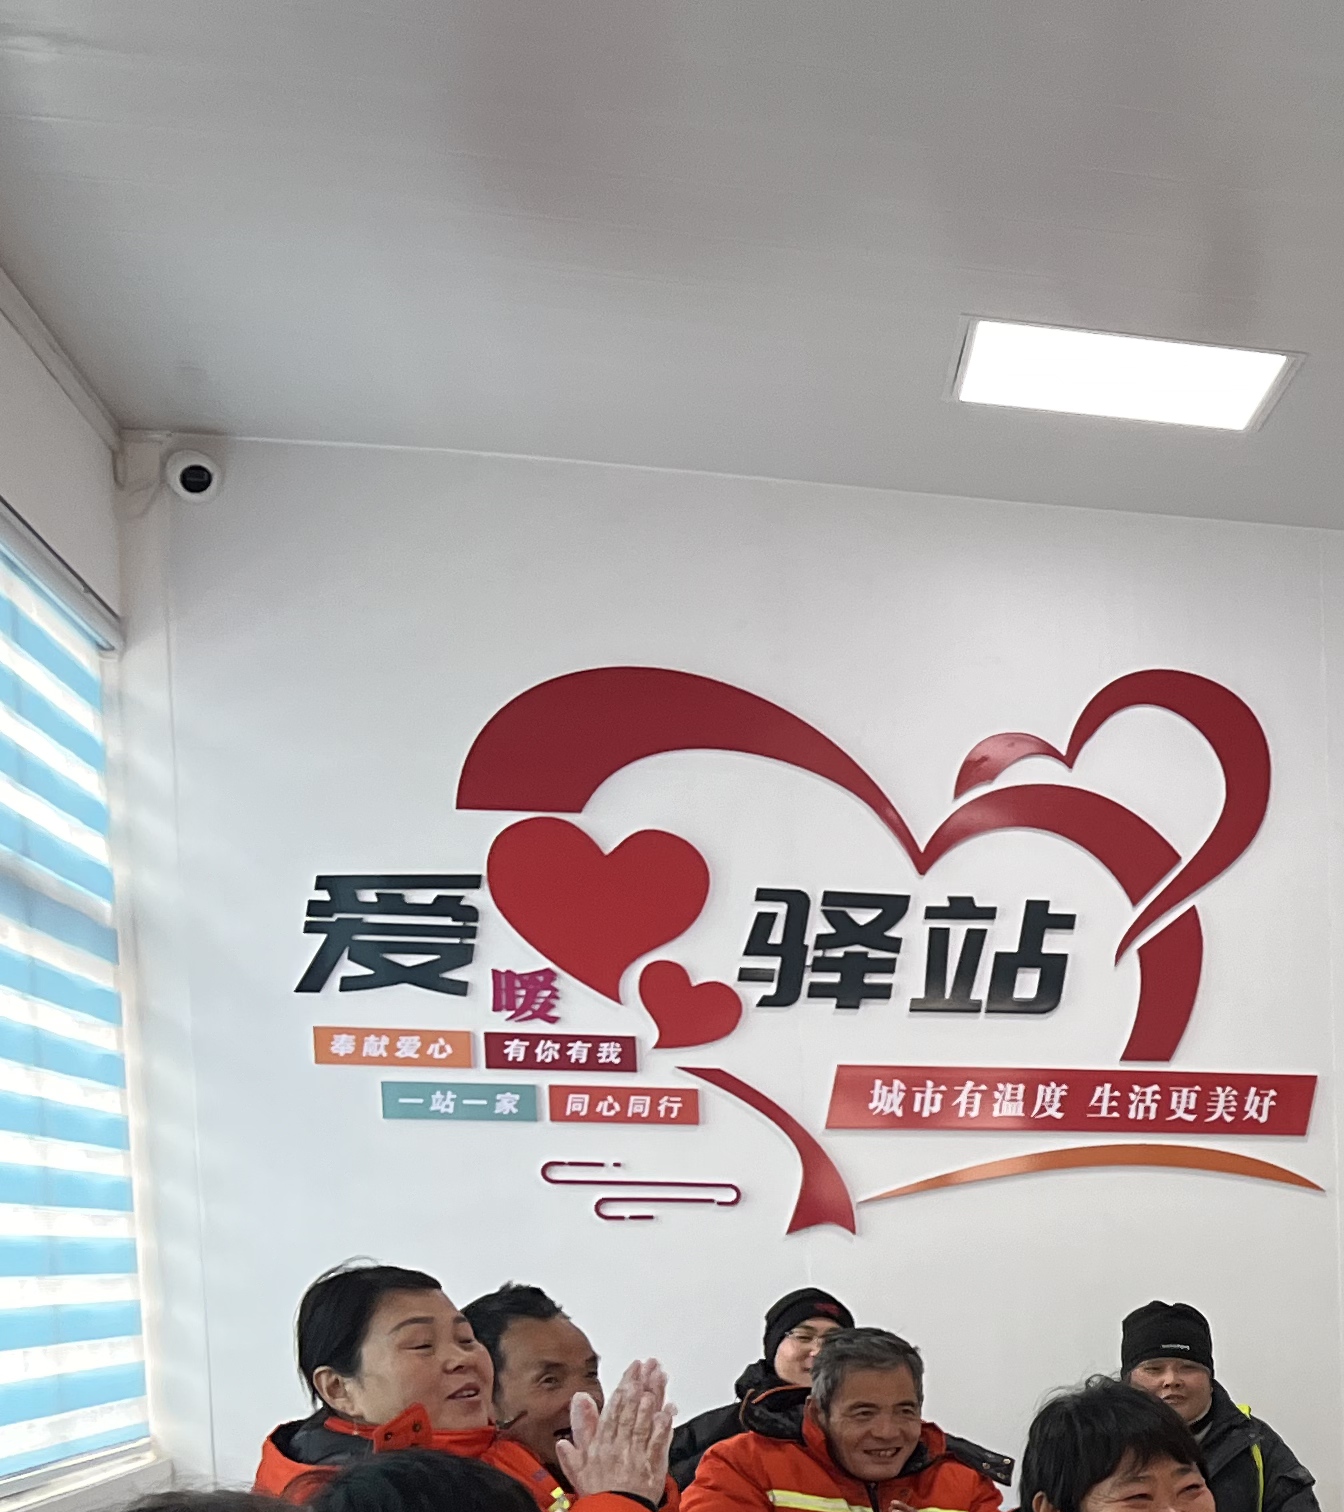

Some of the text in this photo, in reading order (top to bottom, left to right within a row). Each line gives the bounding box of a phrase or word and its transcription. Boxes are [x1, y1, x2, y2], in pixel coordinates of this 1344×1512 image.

[737, 887, 1077, 1014] 驿站
[330, 1033, 453, 1059] 奉献爱心
[502, 1038, 624, 1065] 有你有我
[397, 1090, 521, 1115] 一站一家
[565, 1093, 684, 1119] 同心同行
[868, 1078, 1278, 1124] 城市有温度 生活更美好
